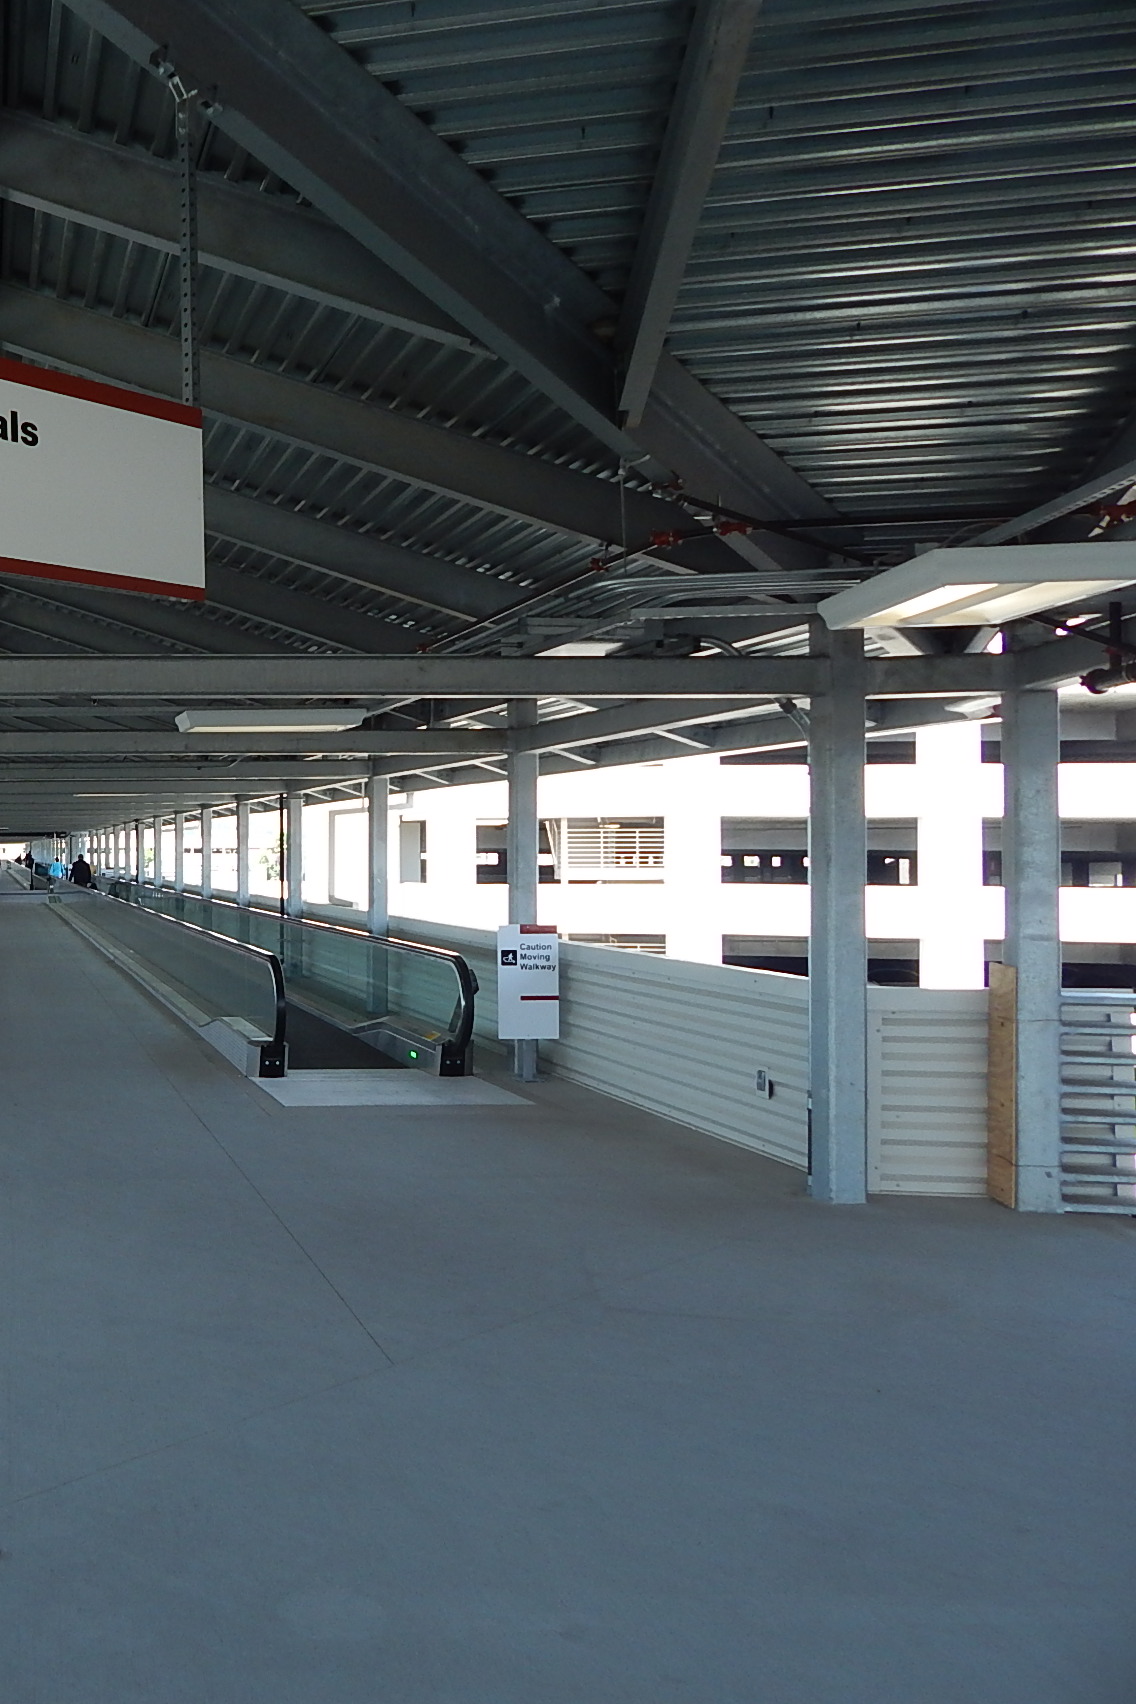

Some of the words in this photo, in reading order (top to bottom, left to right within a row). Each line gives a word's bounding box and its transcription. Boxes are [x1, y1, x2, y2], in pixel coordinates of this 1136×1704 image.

[519, 943, 552, 951] Caution
[519, 953, 551, 962] Moving
[519, 963, 557, 972] Walkway
